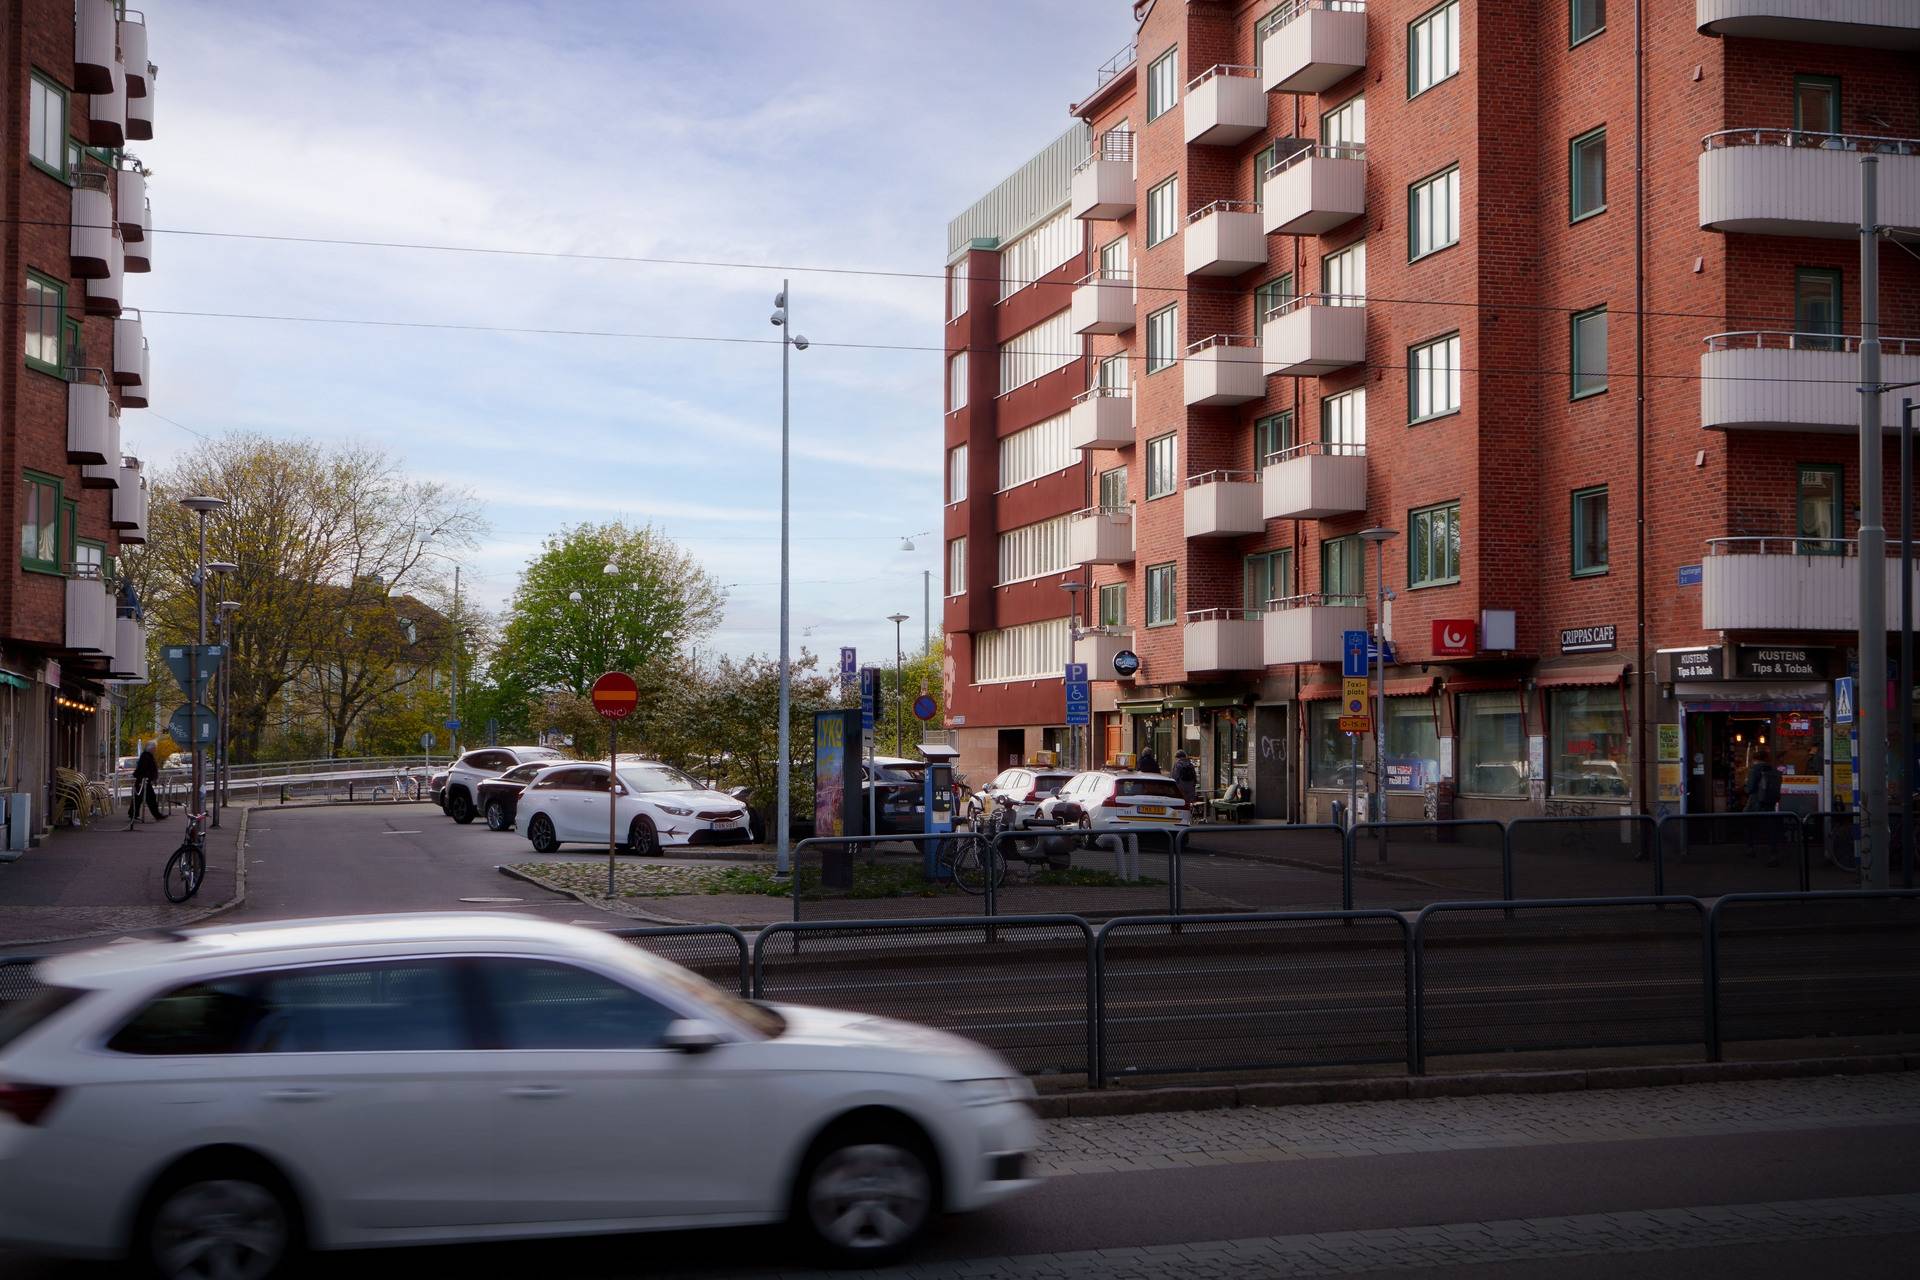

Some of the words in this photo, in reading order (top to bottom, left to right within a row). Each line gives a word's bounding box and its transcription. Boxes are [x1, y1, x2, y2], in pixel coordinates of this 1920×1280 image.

[1561, 628, 1592, 645] CRIPPAS
[1593, 626, 1614, 642] CAFE
[845, 650, 853, 671] P
[1681, 653, 1709, 664] KUSTENS
[1759, 651, 1806, 661] KUSTENS
[1072, 665, 1083, 681] P
[1677, 667, 1690, 678] Tips
[1690, 667, 1695, 675] &
[1696, 666, 1713, 676] Tobak
[1752, 663, 1772, 674] Tips
[1774, 664, 1782, 673] &
[1784, 664, 1813, 674] Tobak
[864, 671, 870, 694] P
[817, 719, 843, 748] LYKO
